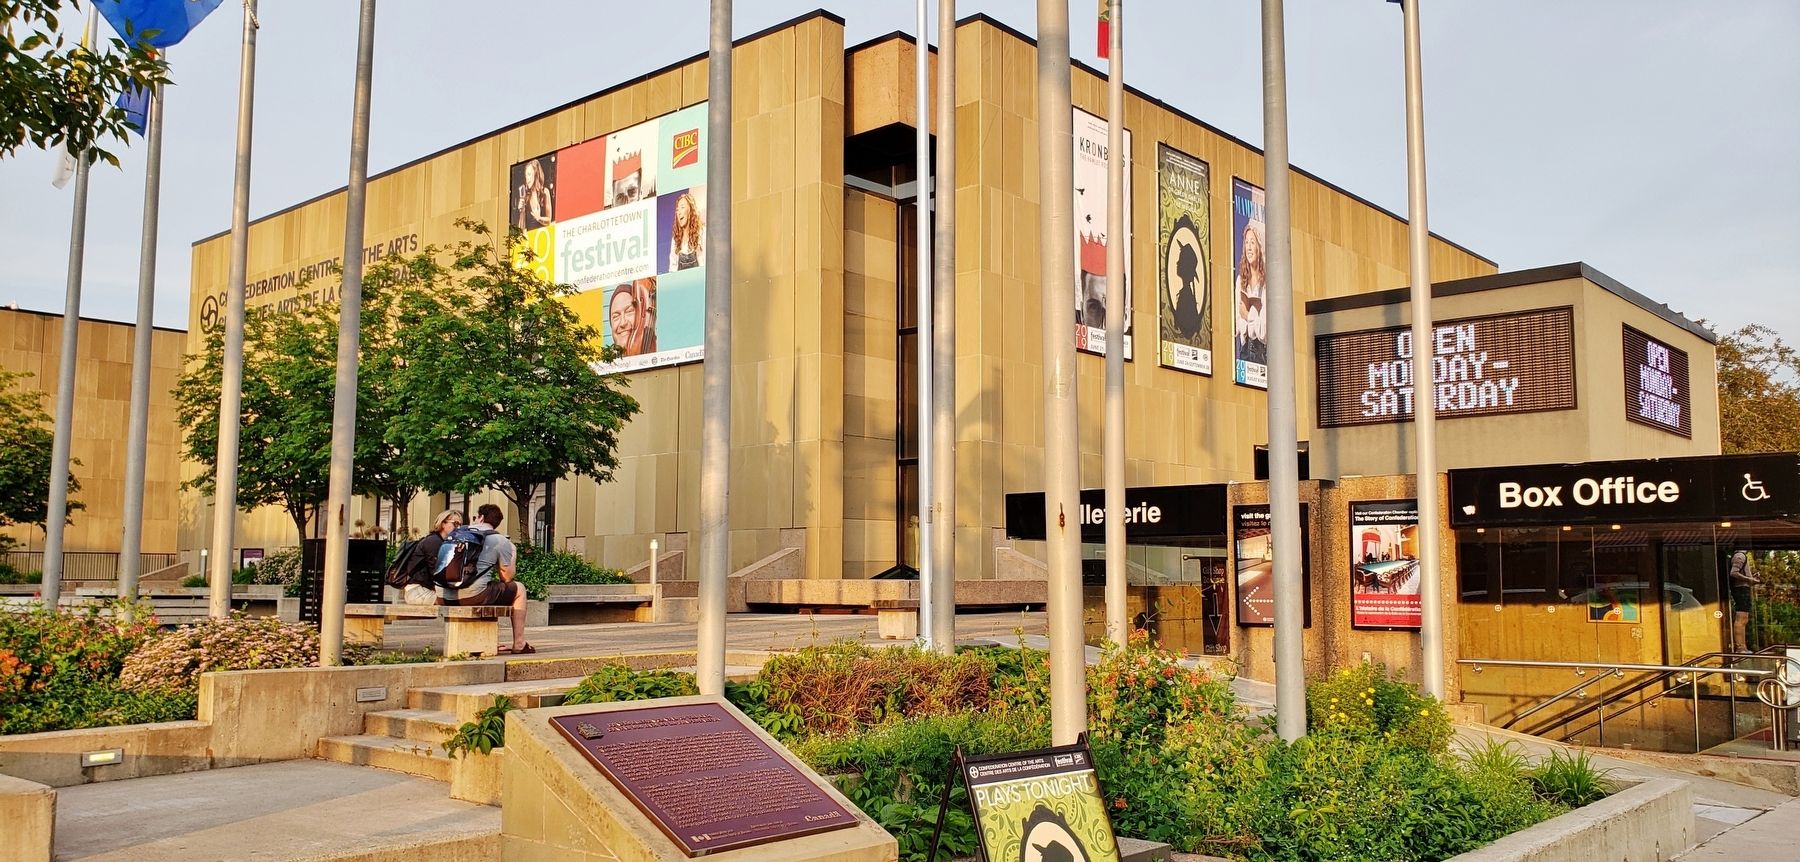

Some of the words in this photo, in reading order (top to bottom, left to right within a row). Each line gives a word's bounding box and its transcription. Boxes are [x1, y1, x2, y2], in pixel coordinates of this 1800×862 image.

[674, 132, 697, 150] CIBC
[1169, 171, 1200, 195] ANNE
[563, 228, 575, 238] THE
[577, 210, 642, 235] CHARLOTTETOWN
[219, 270, 295, 307] CEDERATION
[362, 242, 384, 265] THE
[388, 233, 418, 257] ARTS
[323, 286, 335, 305] LA
[1397, 323, 1474, 358] OEN
[1368, 351, 1509, 389] MODAY-
[1647, 341, 1669, 373] OPEN
[1361, 377, 1519, 416] SATRDAY
[1639, 390, 1680, 428] SATURDAY
[1499, 481, 1564, 509] Box
[1572, 476, 1680, 507] Office
[979, 763, 1008, 772] CONFEDERATION
[980, 769, 994, 777] CENTRE
[976, 788, 1021, 808] PLAYS
[1023, 774, 1091, 801] TONIGHT
[804, 811, 842, 823] Canada
